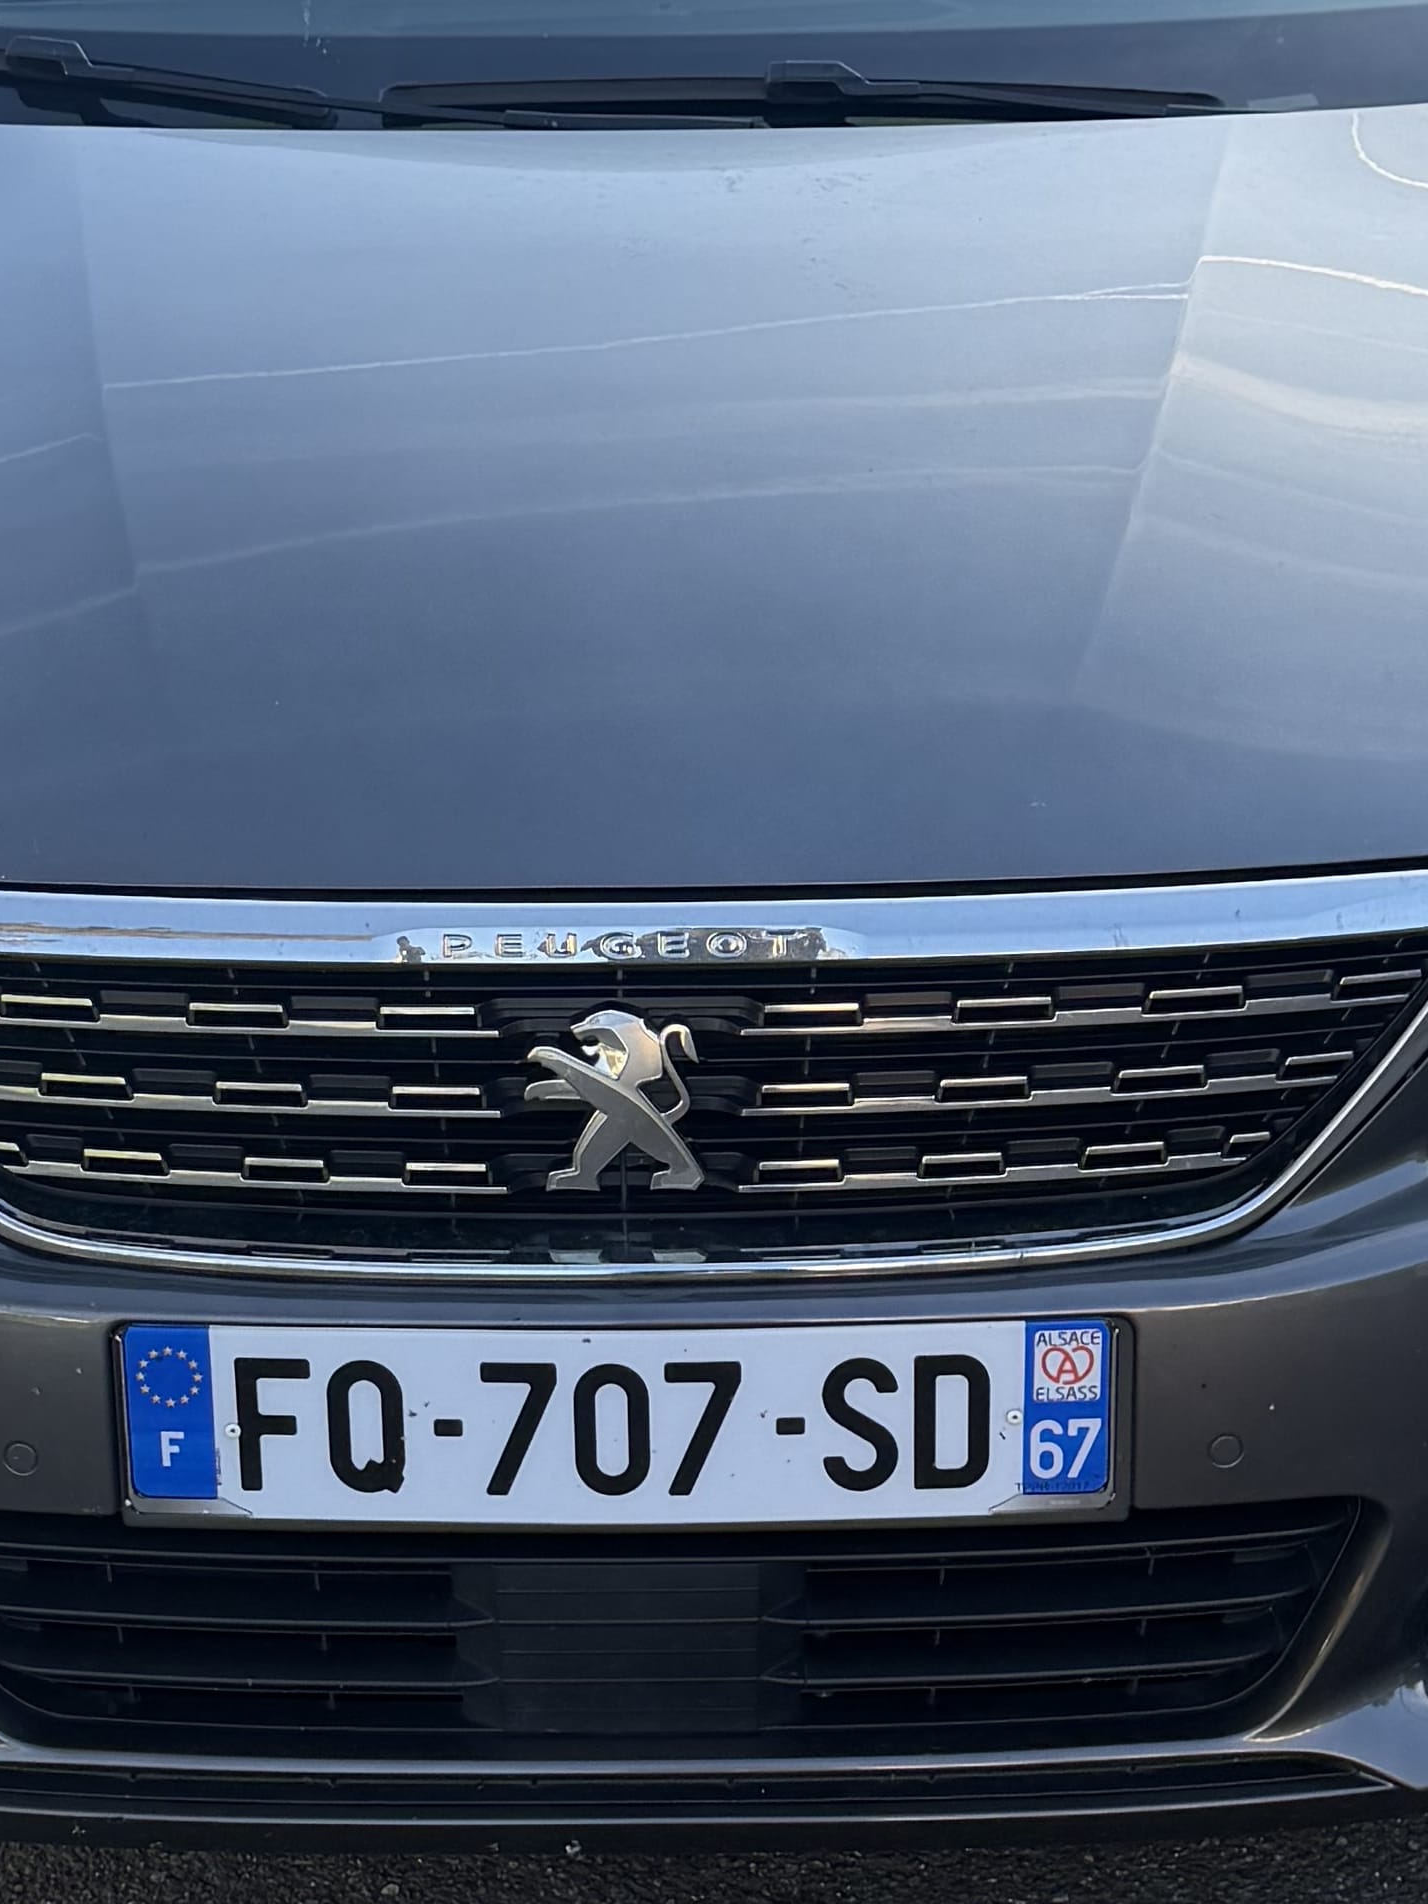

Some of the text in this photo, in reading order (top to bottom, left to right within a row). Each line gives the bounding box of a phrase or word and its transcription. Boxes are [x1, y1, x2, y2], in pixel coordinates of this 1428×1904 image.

[442, 931, 801, 959] PEUGEOT
[1036, 1330, 1101, 1346] ALSACE
[1036, 1385, 1098, 1402] ELSASS
[234, 1354, 991, 1496] FQ-707-SD
[160, 1431, 184, 1467] F
[1029, 1418, 1102, 1480] 67
